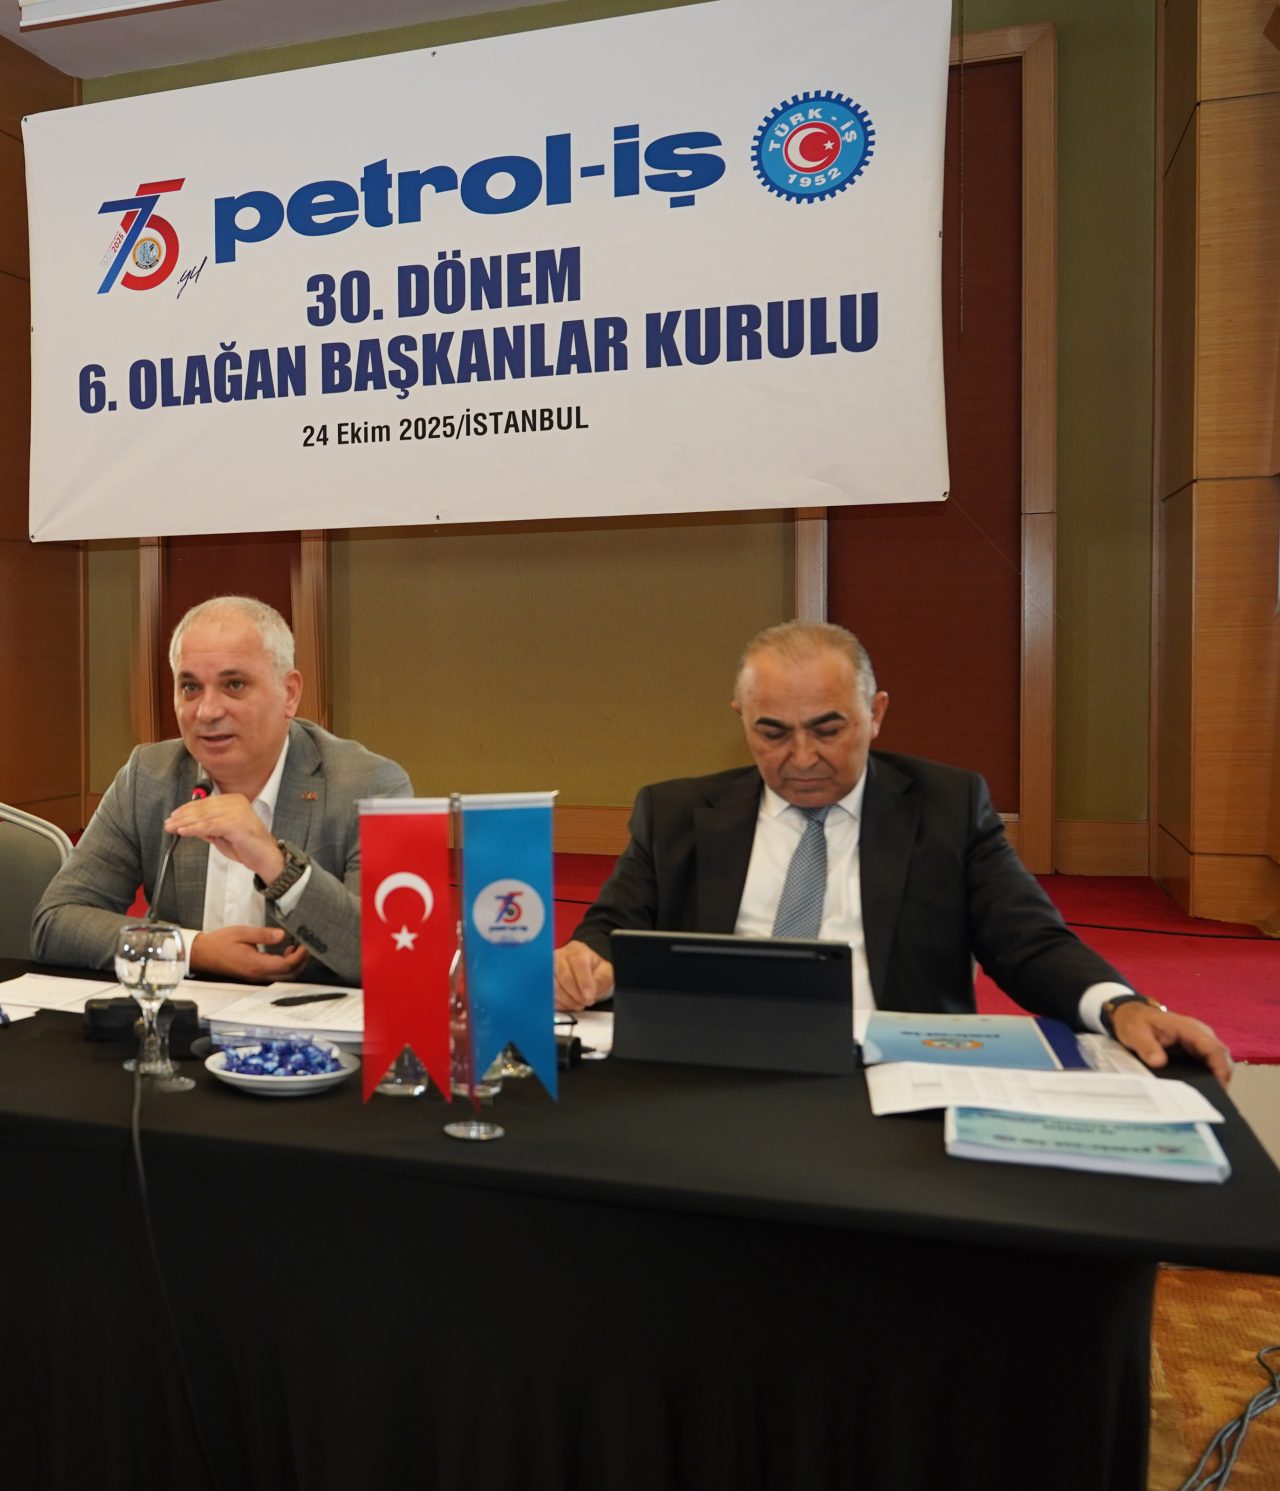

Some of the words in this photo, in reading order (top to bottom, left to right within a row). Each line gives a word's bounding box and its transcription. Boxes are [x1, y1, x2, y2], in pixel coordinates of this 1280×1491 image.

[213, 123, 726, 265] petrol-iş
[788, 167, 842, 188] 1952
[111, 232, 124, 253] 2025
[306, 269, 385, 327] 30.
[397, 246, 582, 319] DÖNEM
[78, 363, 117, 414] 6.
[128, 340, 307, 410] OLAĞAN
[321, 316, 628, 400] BAŞKANLAR
[645, 291, 879, 369] KURULU
[302, 424, 329, 448] 24
[337, 422, 391, 445] Ekim
[399, 405, 589, 441] 2025/İSTANBUL
